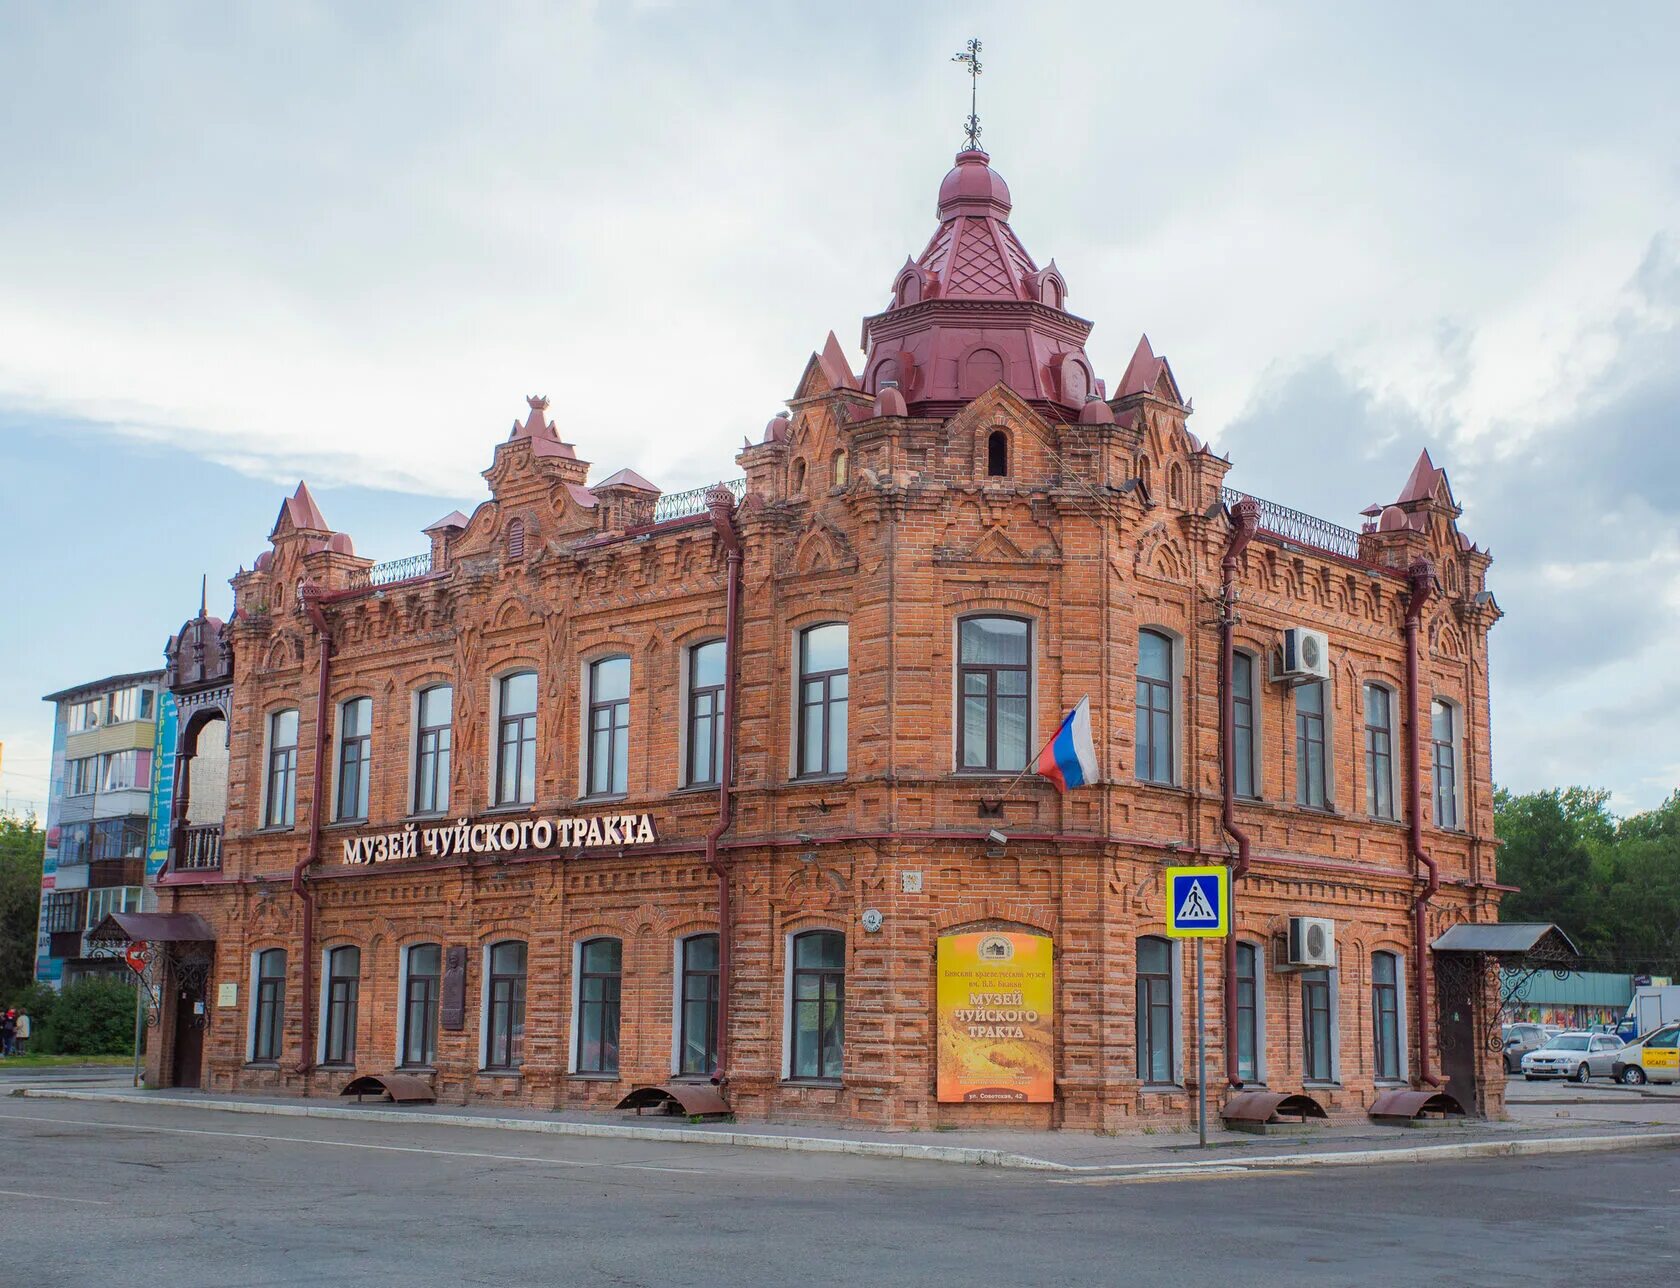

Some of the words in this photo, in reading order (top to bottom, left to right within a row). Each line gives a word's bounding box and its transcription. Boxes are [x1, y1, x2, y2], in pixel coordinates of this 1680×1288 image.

[150, 694, 167, 848] СЕРТИФИКАЦИЯ
[342, 823, 418, 866] МУЗЕЙ
[423, 818, 552, 857] ЧУЙСКОГО
[558, 813, 656, 848] ТРАКТА
[969, 990, 1024, 1006] МУЗЕЙ
[955, 1007, 1038, 1022] ЧУЙСКОГО
[968, 1026, 1024, 1038] ТРАКТА
